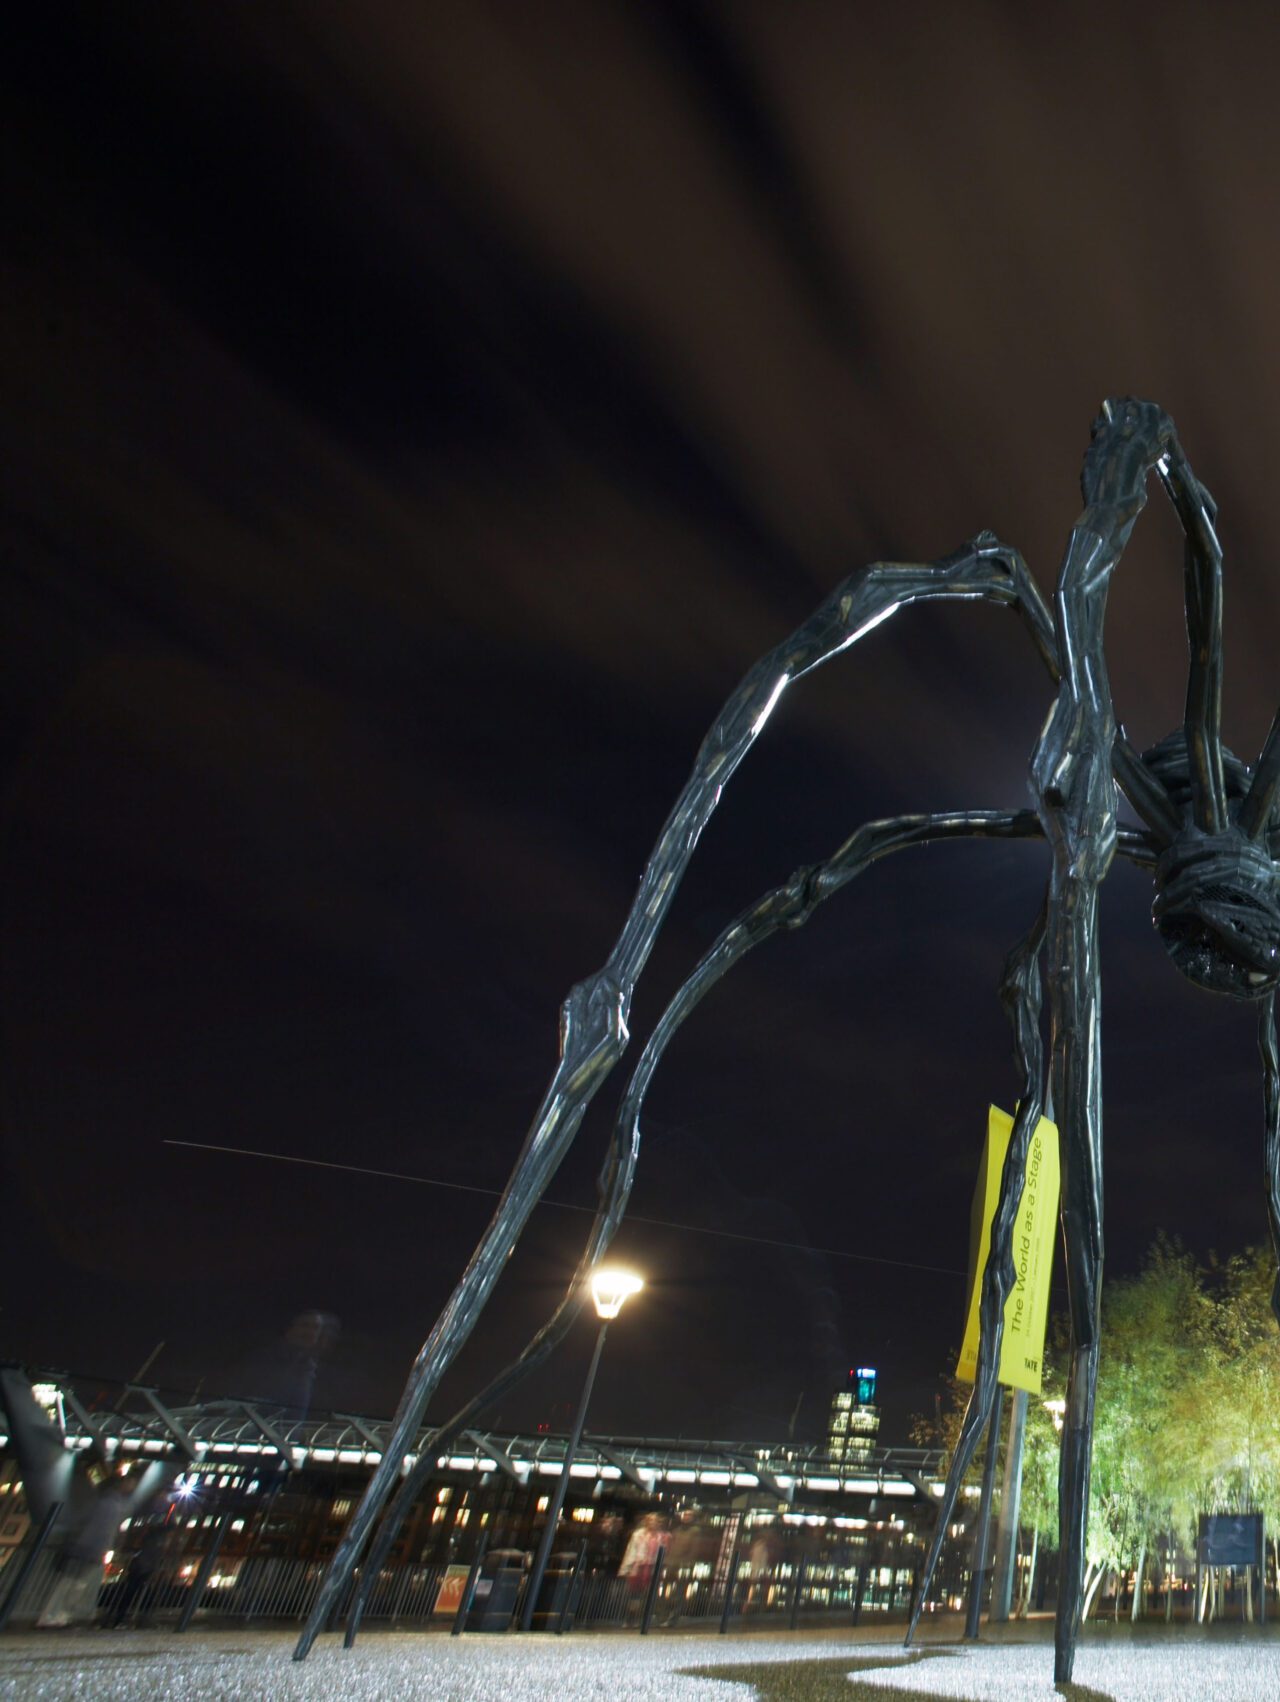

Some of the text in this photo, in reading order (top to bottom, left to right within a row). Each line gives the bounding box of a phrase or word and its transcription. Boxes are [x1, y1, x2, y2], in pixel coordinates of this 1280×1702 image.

[1028, 1137, 1042, 1189] Stage
[1028, 1194, 1035, 1206] a
[1025, 1210, 1033, 1232] as
[1016, 1235, 1031, 1292] World
[1011, 1299, 1024, 1333] The
[1024, 1358, 1038, 1373] TATE
